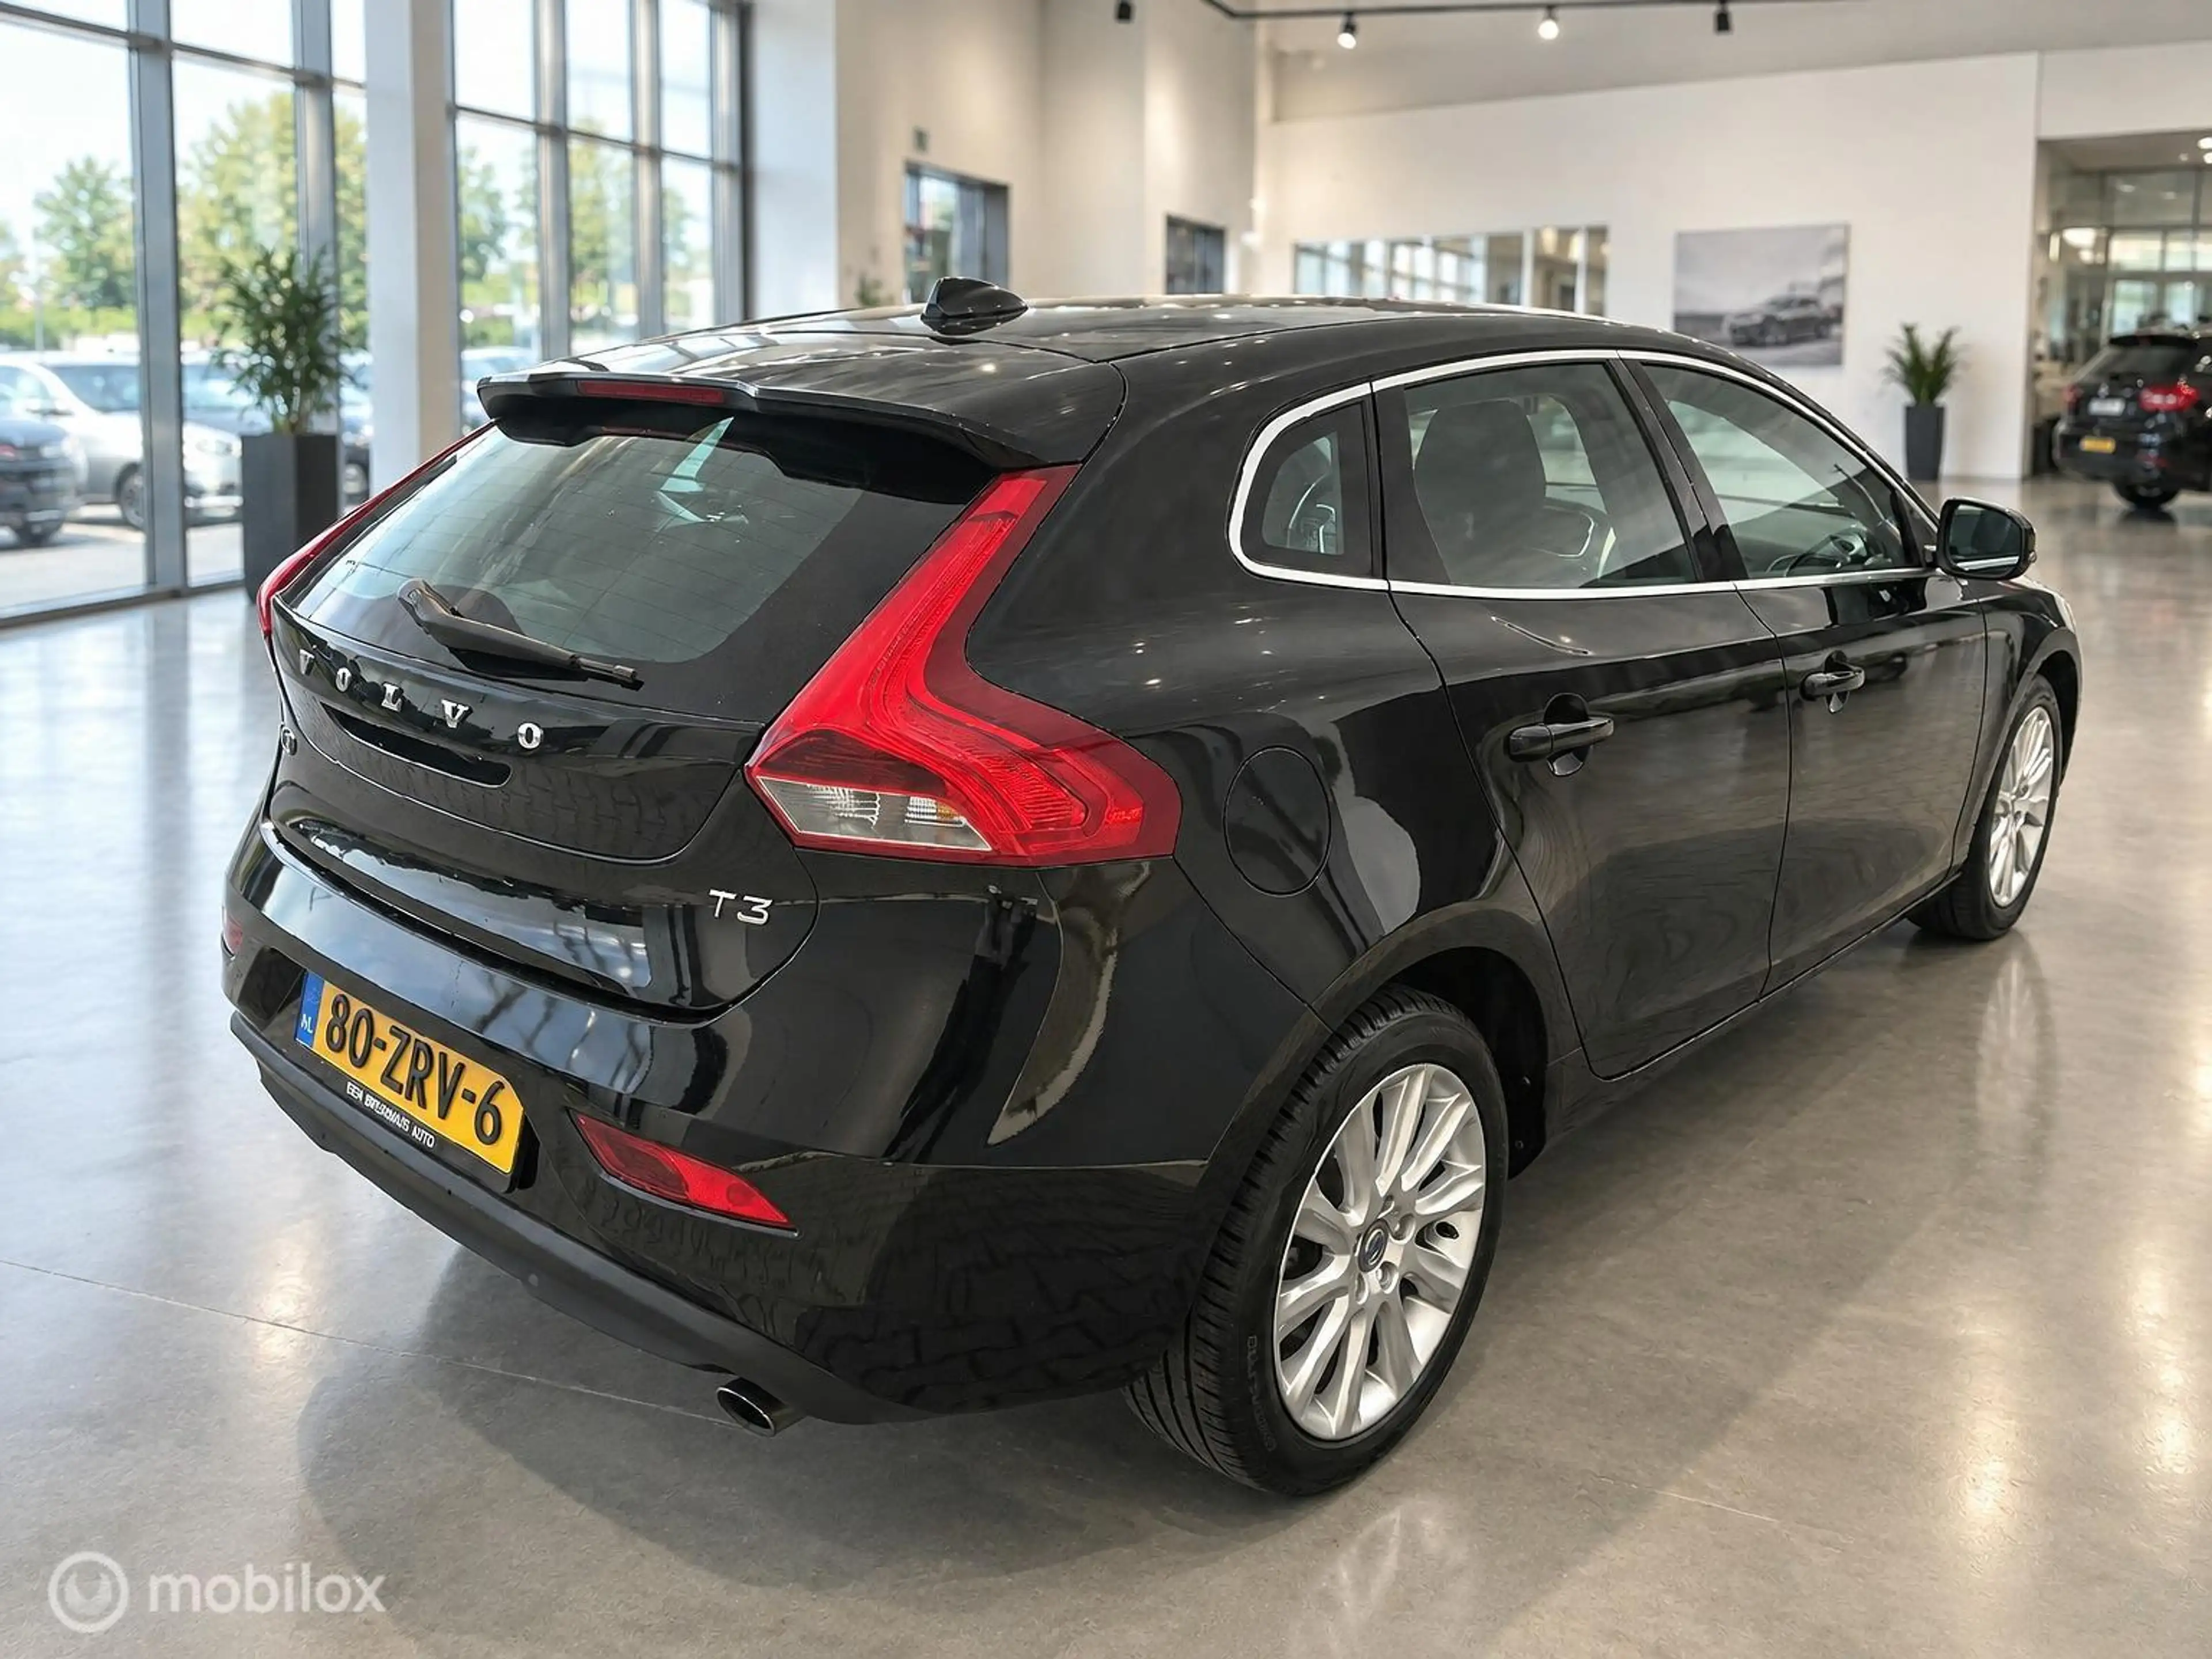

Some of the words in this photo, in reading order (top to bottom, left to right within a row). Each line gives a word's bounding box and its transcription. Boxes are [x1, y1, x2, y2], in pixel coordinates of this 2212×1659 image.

[299, 649, 544, 749] VOLVO
[709, 889, 773, 925] T3
[325, 993, 505, 1146] 80-ZRV-6
